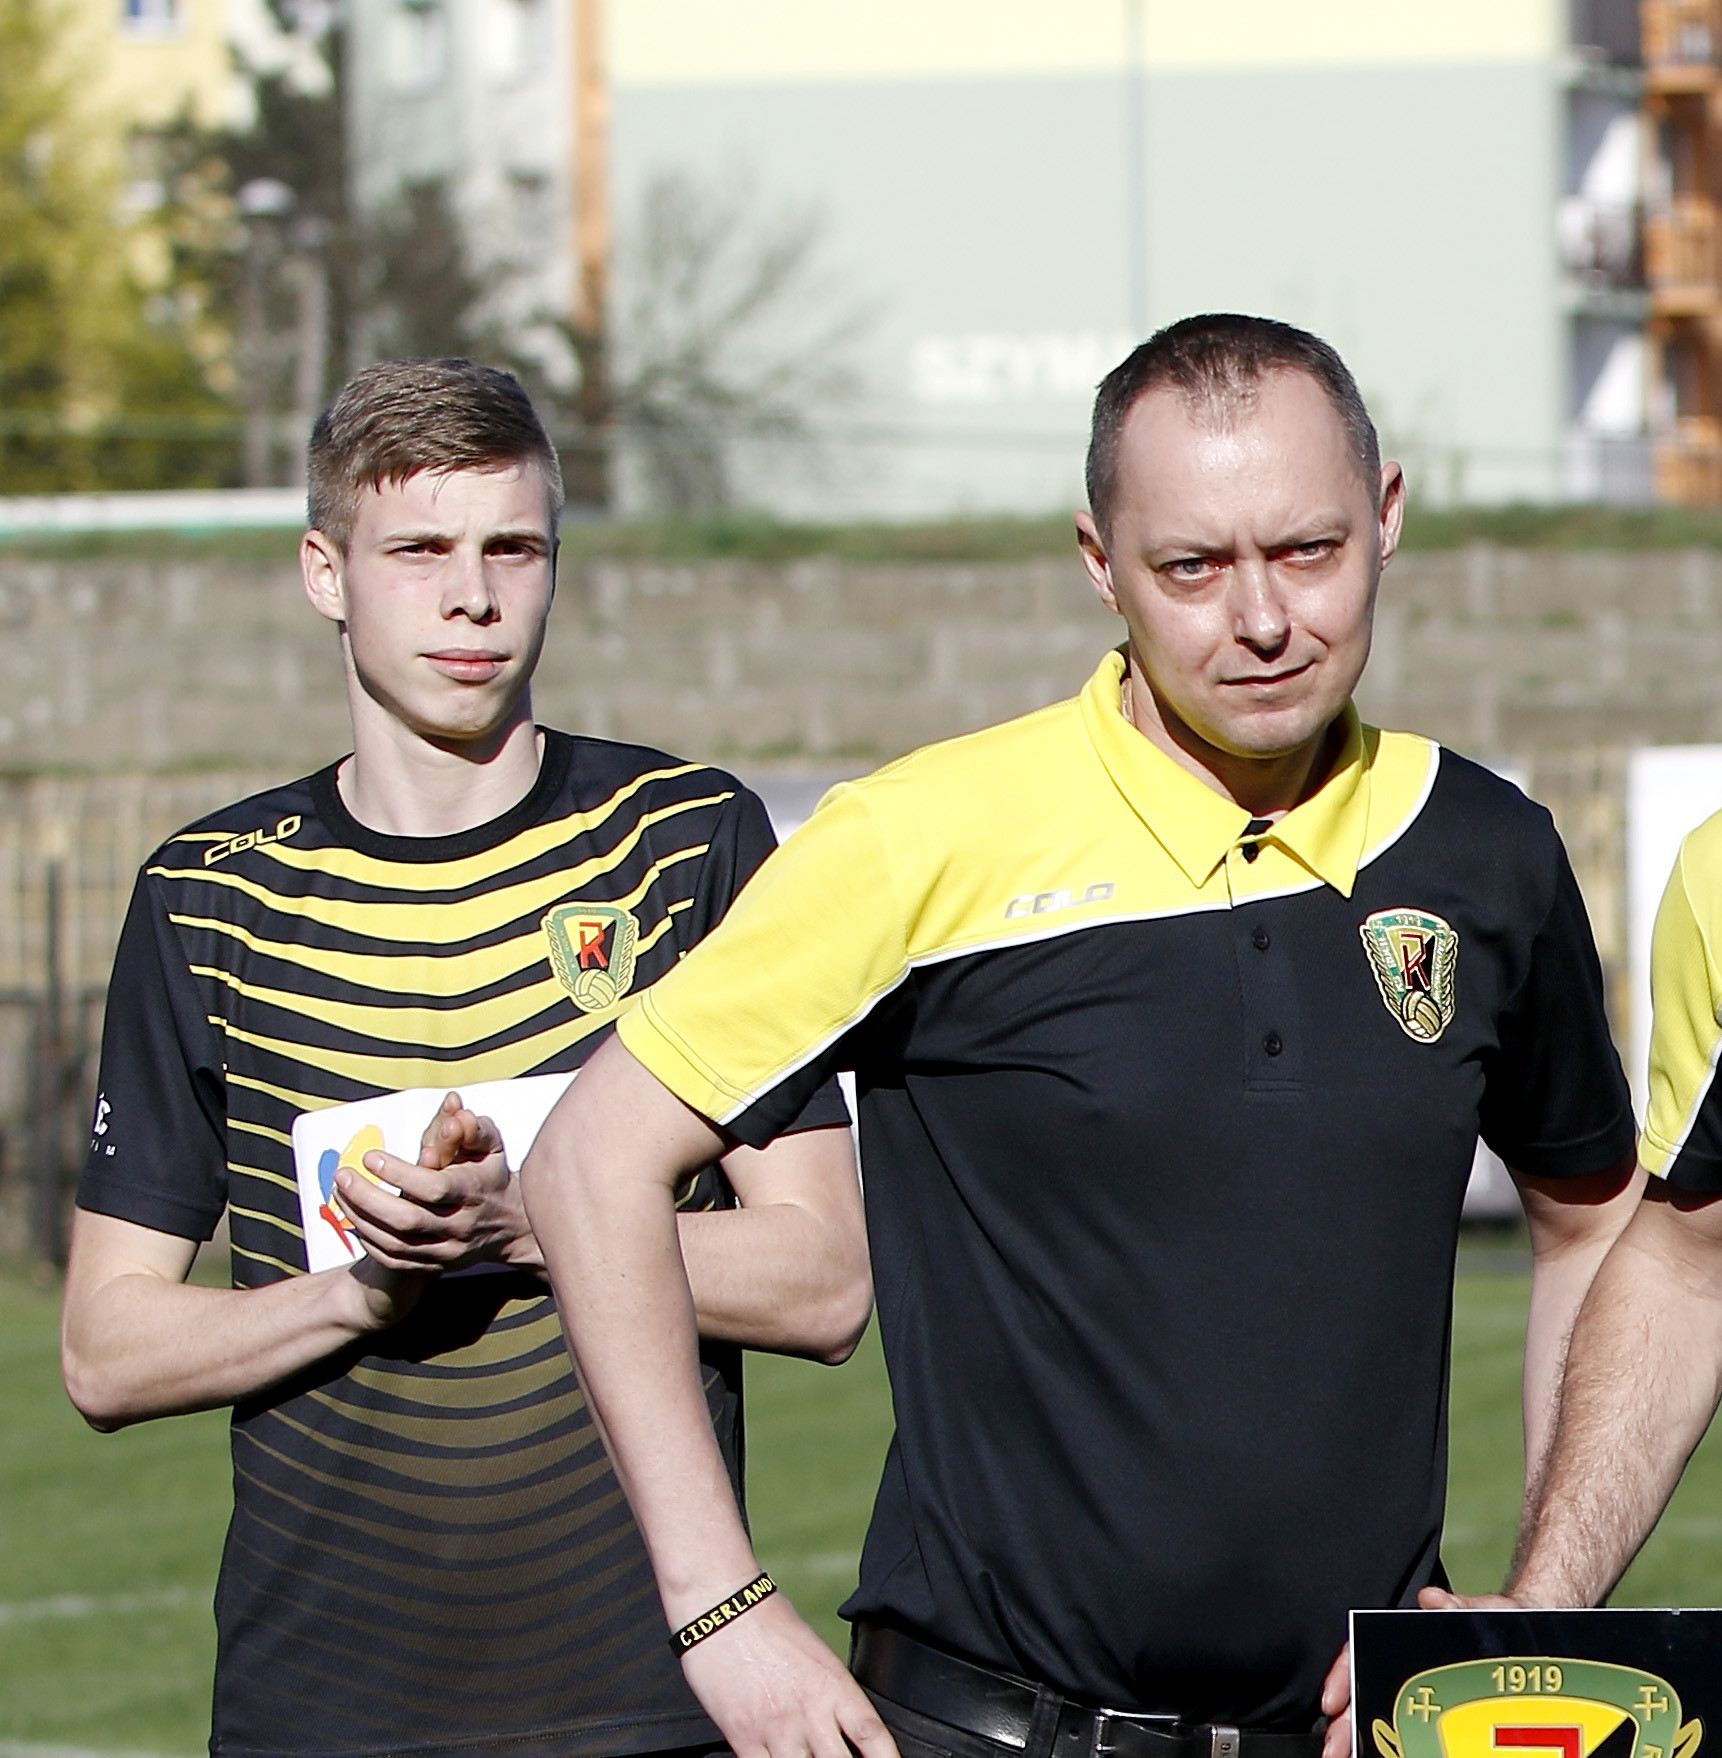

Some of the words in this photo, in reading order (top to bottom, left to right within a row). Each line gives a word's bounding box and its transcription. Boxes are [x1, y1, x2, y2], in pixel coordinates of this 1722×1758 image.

[204, 814, 302, 867] COLO
[1004, 882, 1115, 919] COLO
[680, 1577, 773, 1647] CIDERLAND
[1491, 1665, 1564, 1694] 1919
